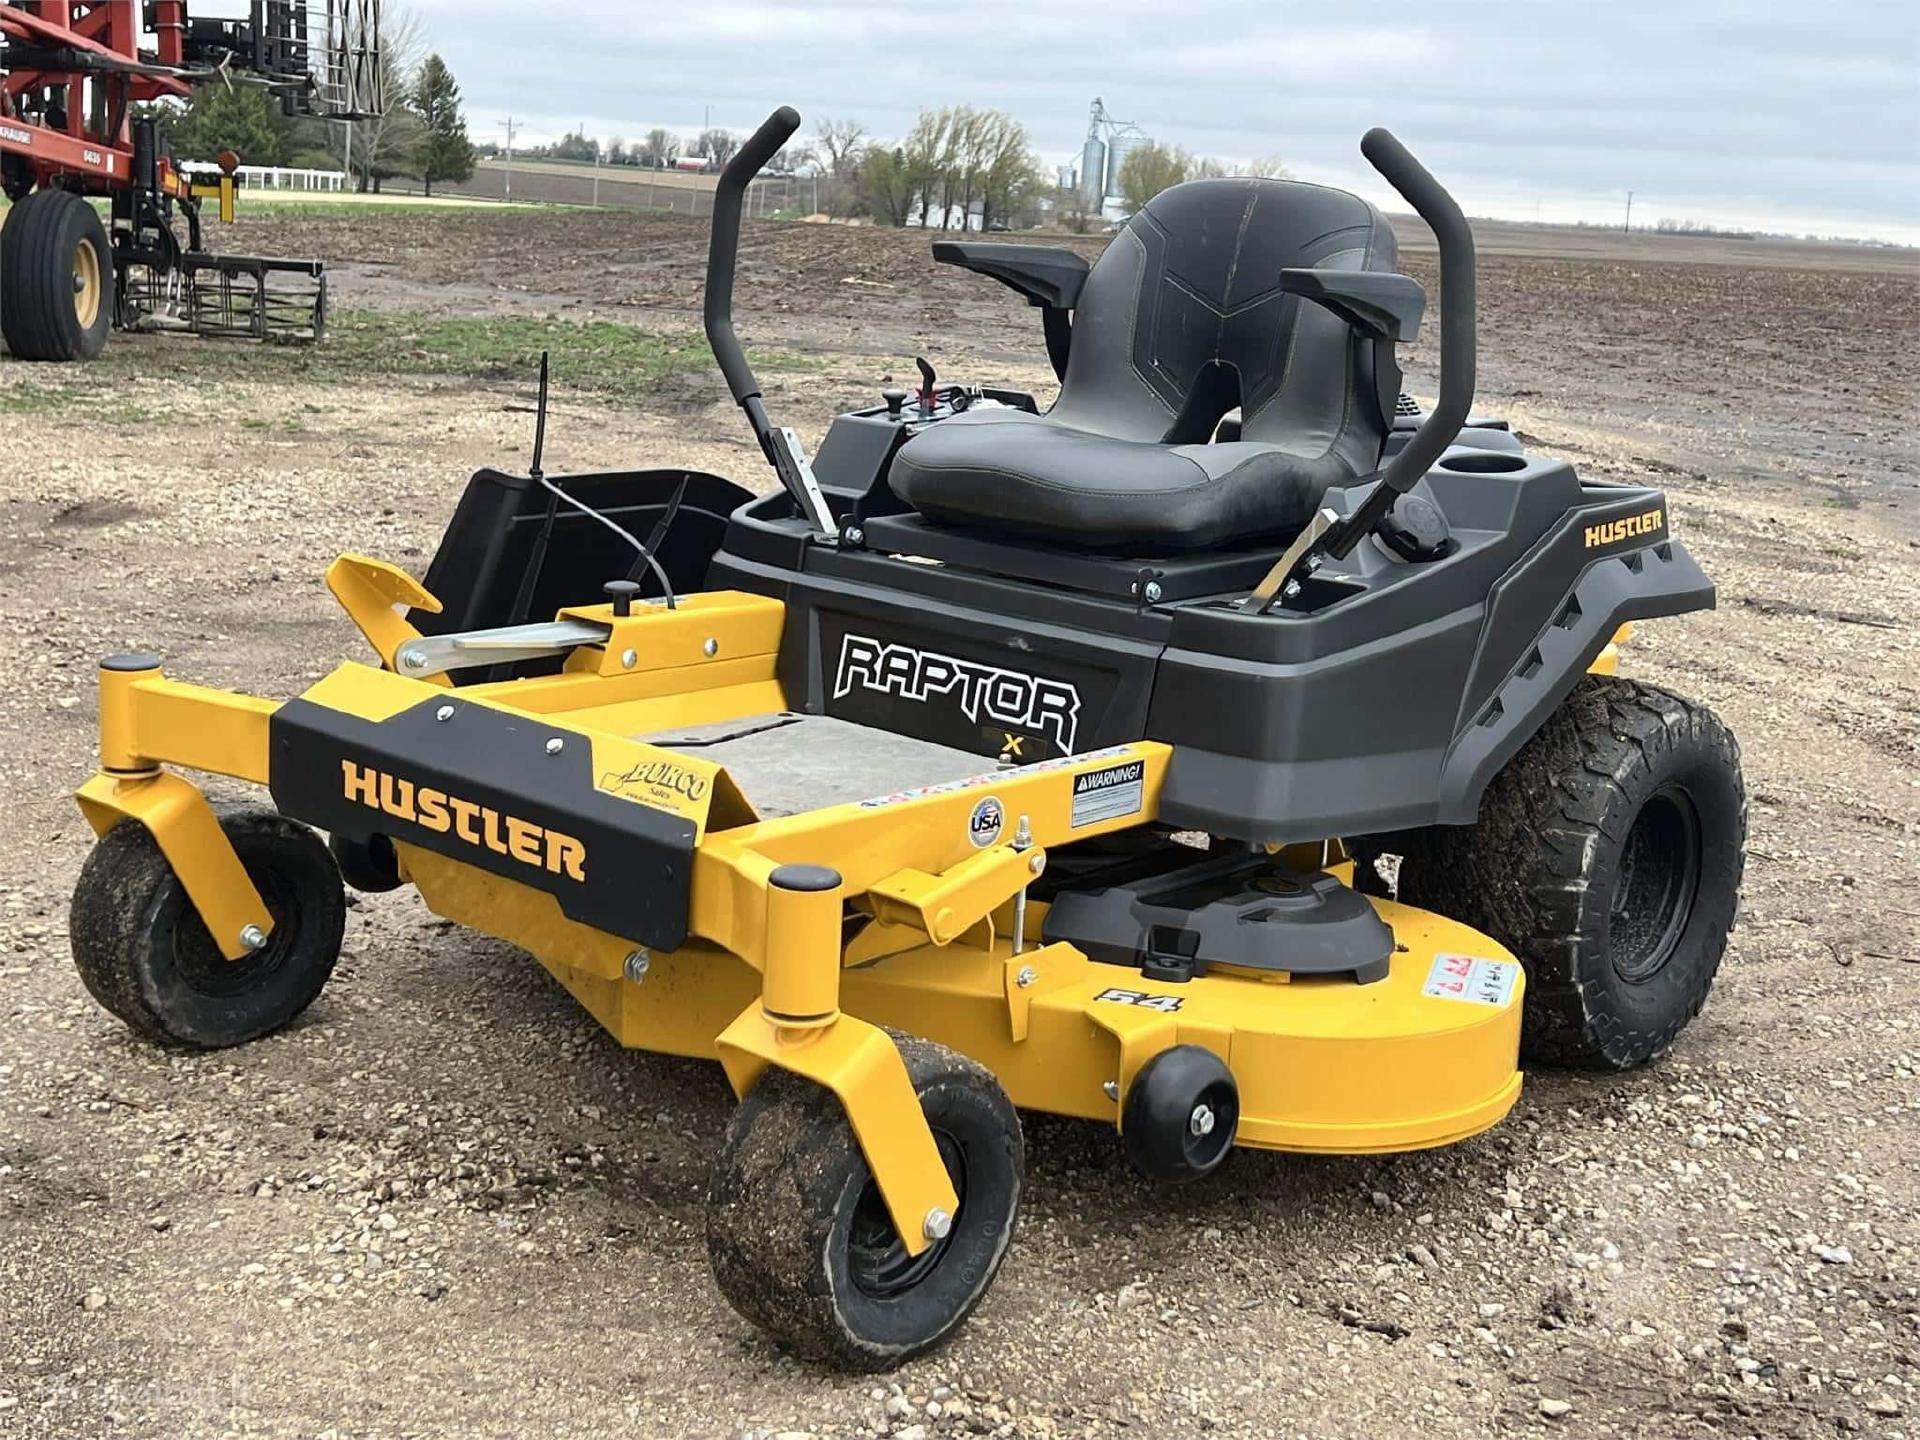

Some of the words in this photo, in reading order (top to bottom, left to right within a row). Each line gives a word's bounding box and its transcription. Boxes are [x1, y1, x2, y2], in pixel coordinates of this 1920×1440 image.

[1584, 509, 1662, 548] HUSTLER
[833, 633, 1082, 757] RAPTOR
[1001, 733, 1025, 756] X
[1087, 764, 1141, 790] WARNING!
[341, 758, 586, 882] HUSTLER
[971, 812, 1002, 833] USA
[1093, 988, 1185, 1012] 54
